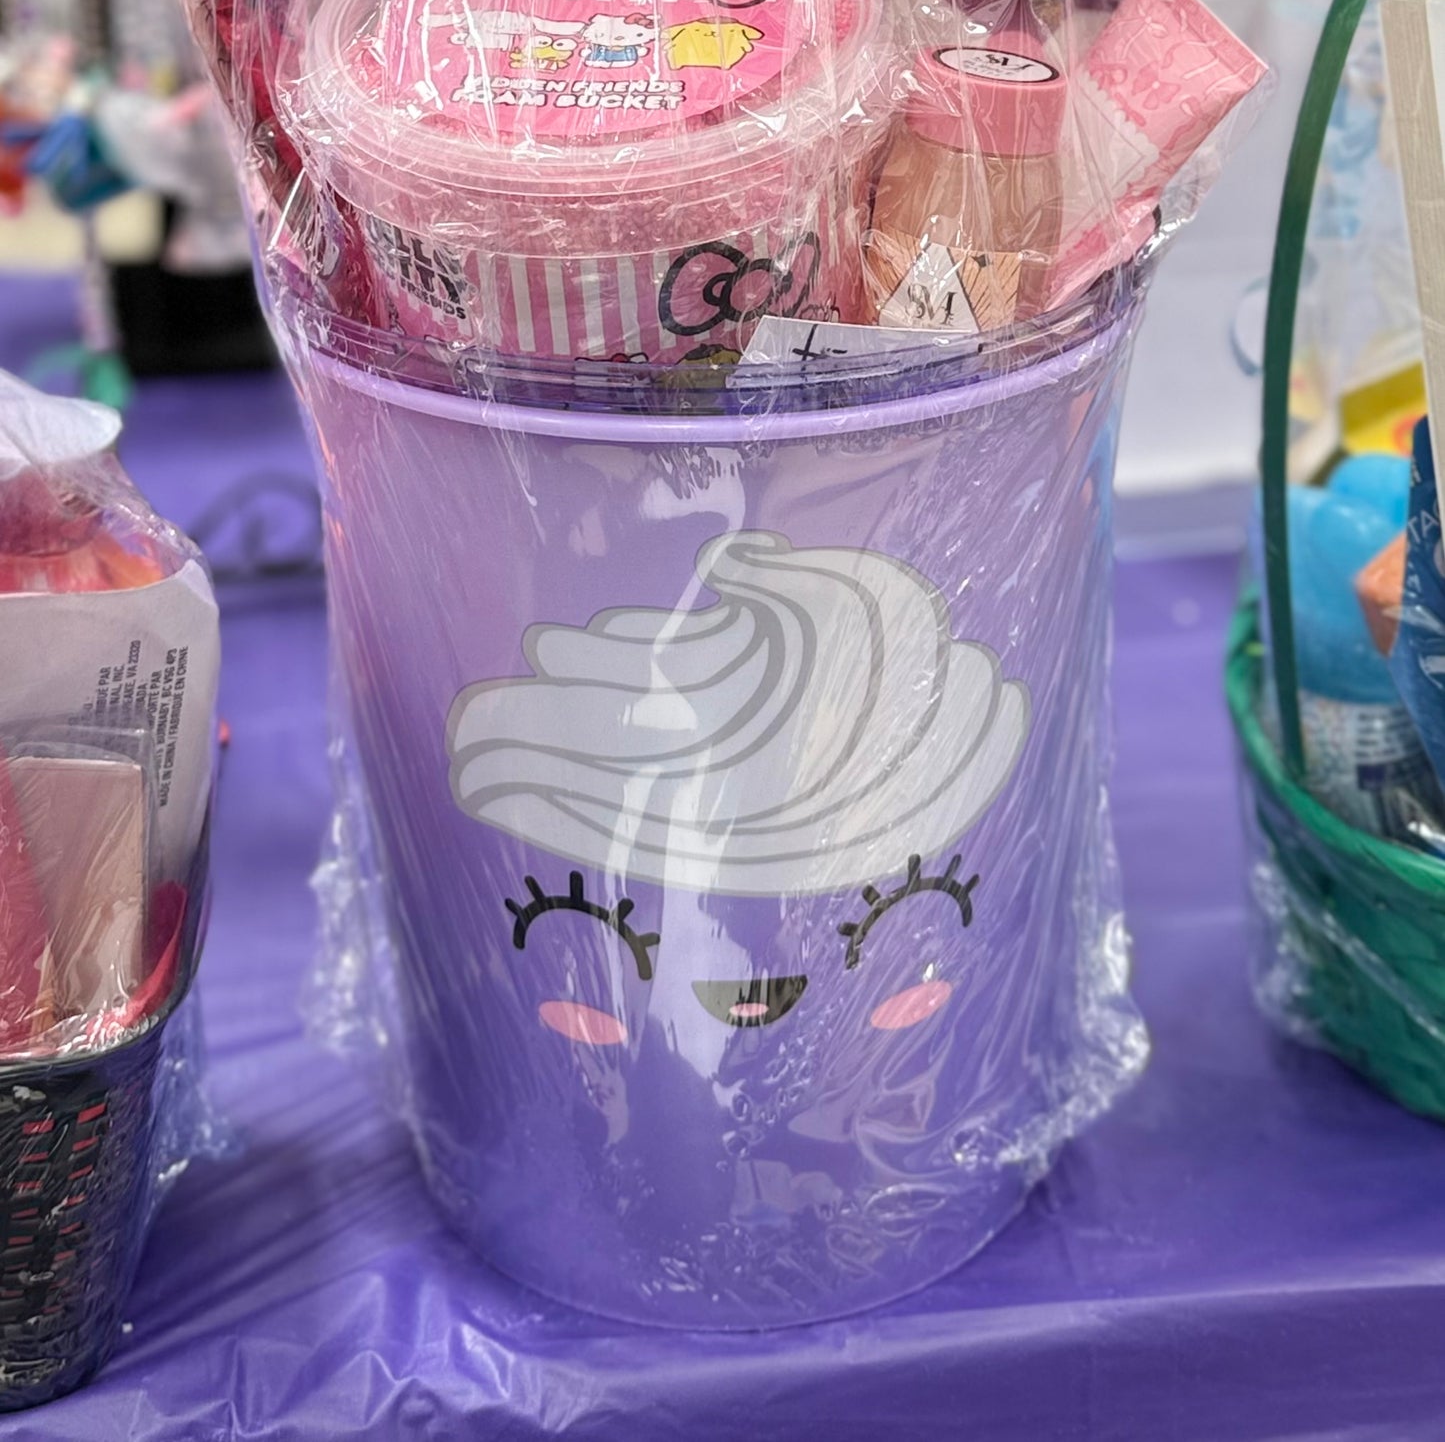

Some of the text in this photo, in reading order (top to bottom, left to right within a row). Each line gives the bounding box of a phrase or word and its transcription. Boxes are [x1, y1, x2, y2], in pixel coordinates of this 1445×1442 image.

[463, 75, 686, 94] HDDEN FRIENDS
[554, 93, 687, 111] BUCKET
[98, 665, 111, 686] PAR
[126, 665, 138, 678] VA
[150, 670, 162, 689] PAR
[161, 685, 173, 698] BC
[175, 677, 186, 690] EN
[163, 741, 176, 769] CHINA
[162, 770, 172, 780] IN
[160, 781, 171, 807] MADE
